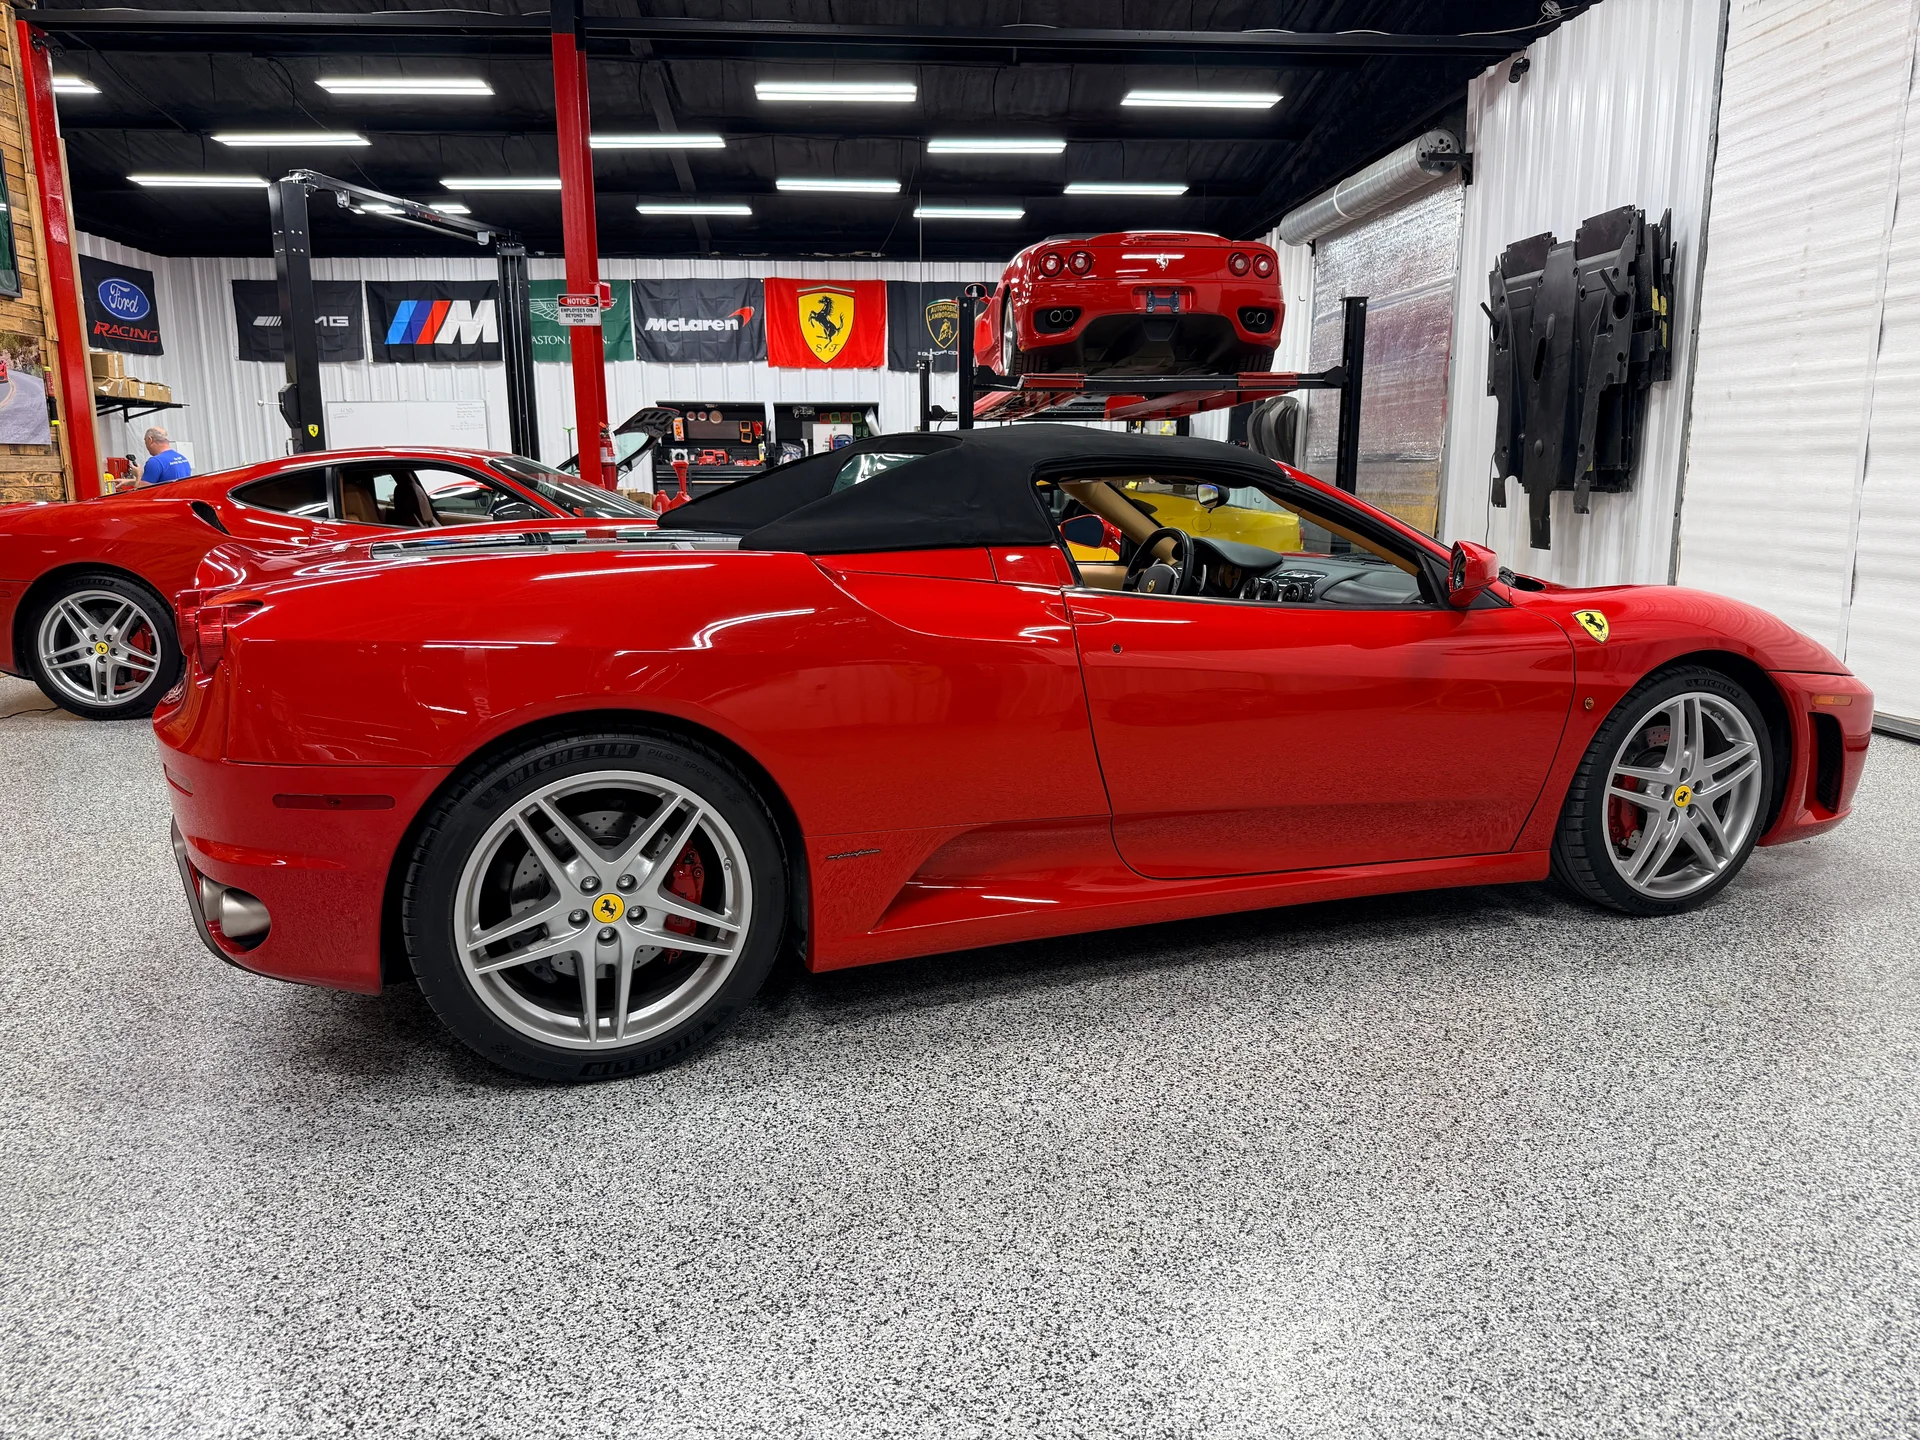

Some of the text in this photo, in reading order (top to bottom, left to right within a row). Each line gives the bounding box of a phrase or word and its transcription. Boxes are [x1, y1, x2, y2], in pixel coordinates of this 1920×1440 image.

[108, 283, 139, 313] Ford
[93, 320, 158, 342] RACING
[645, 317, 739, 332] McLaren
[532, 335, 566, 345] ASTON
[815, 343, 823, 353] S
[506, 743, 633, 788] MICHELIN
[647, 748, 681, 762] PILOT
[684, 760, 720, 782] SPORT
